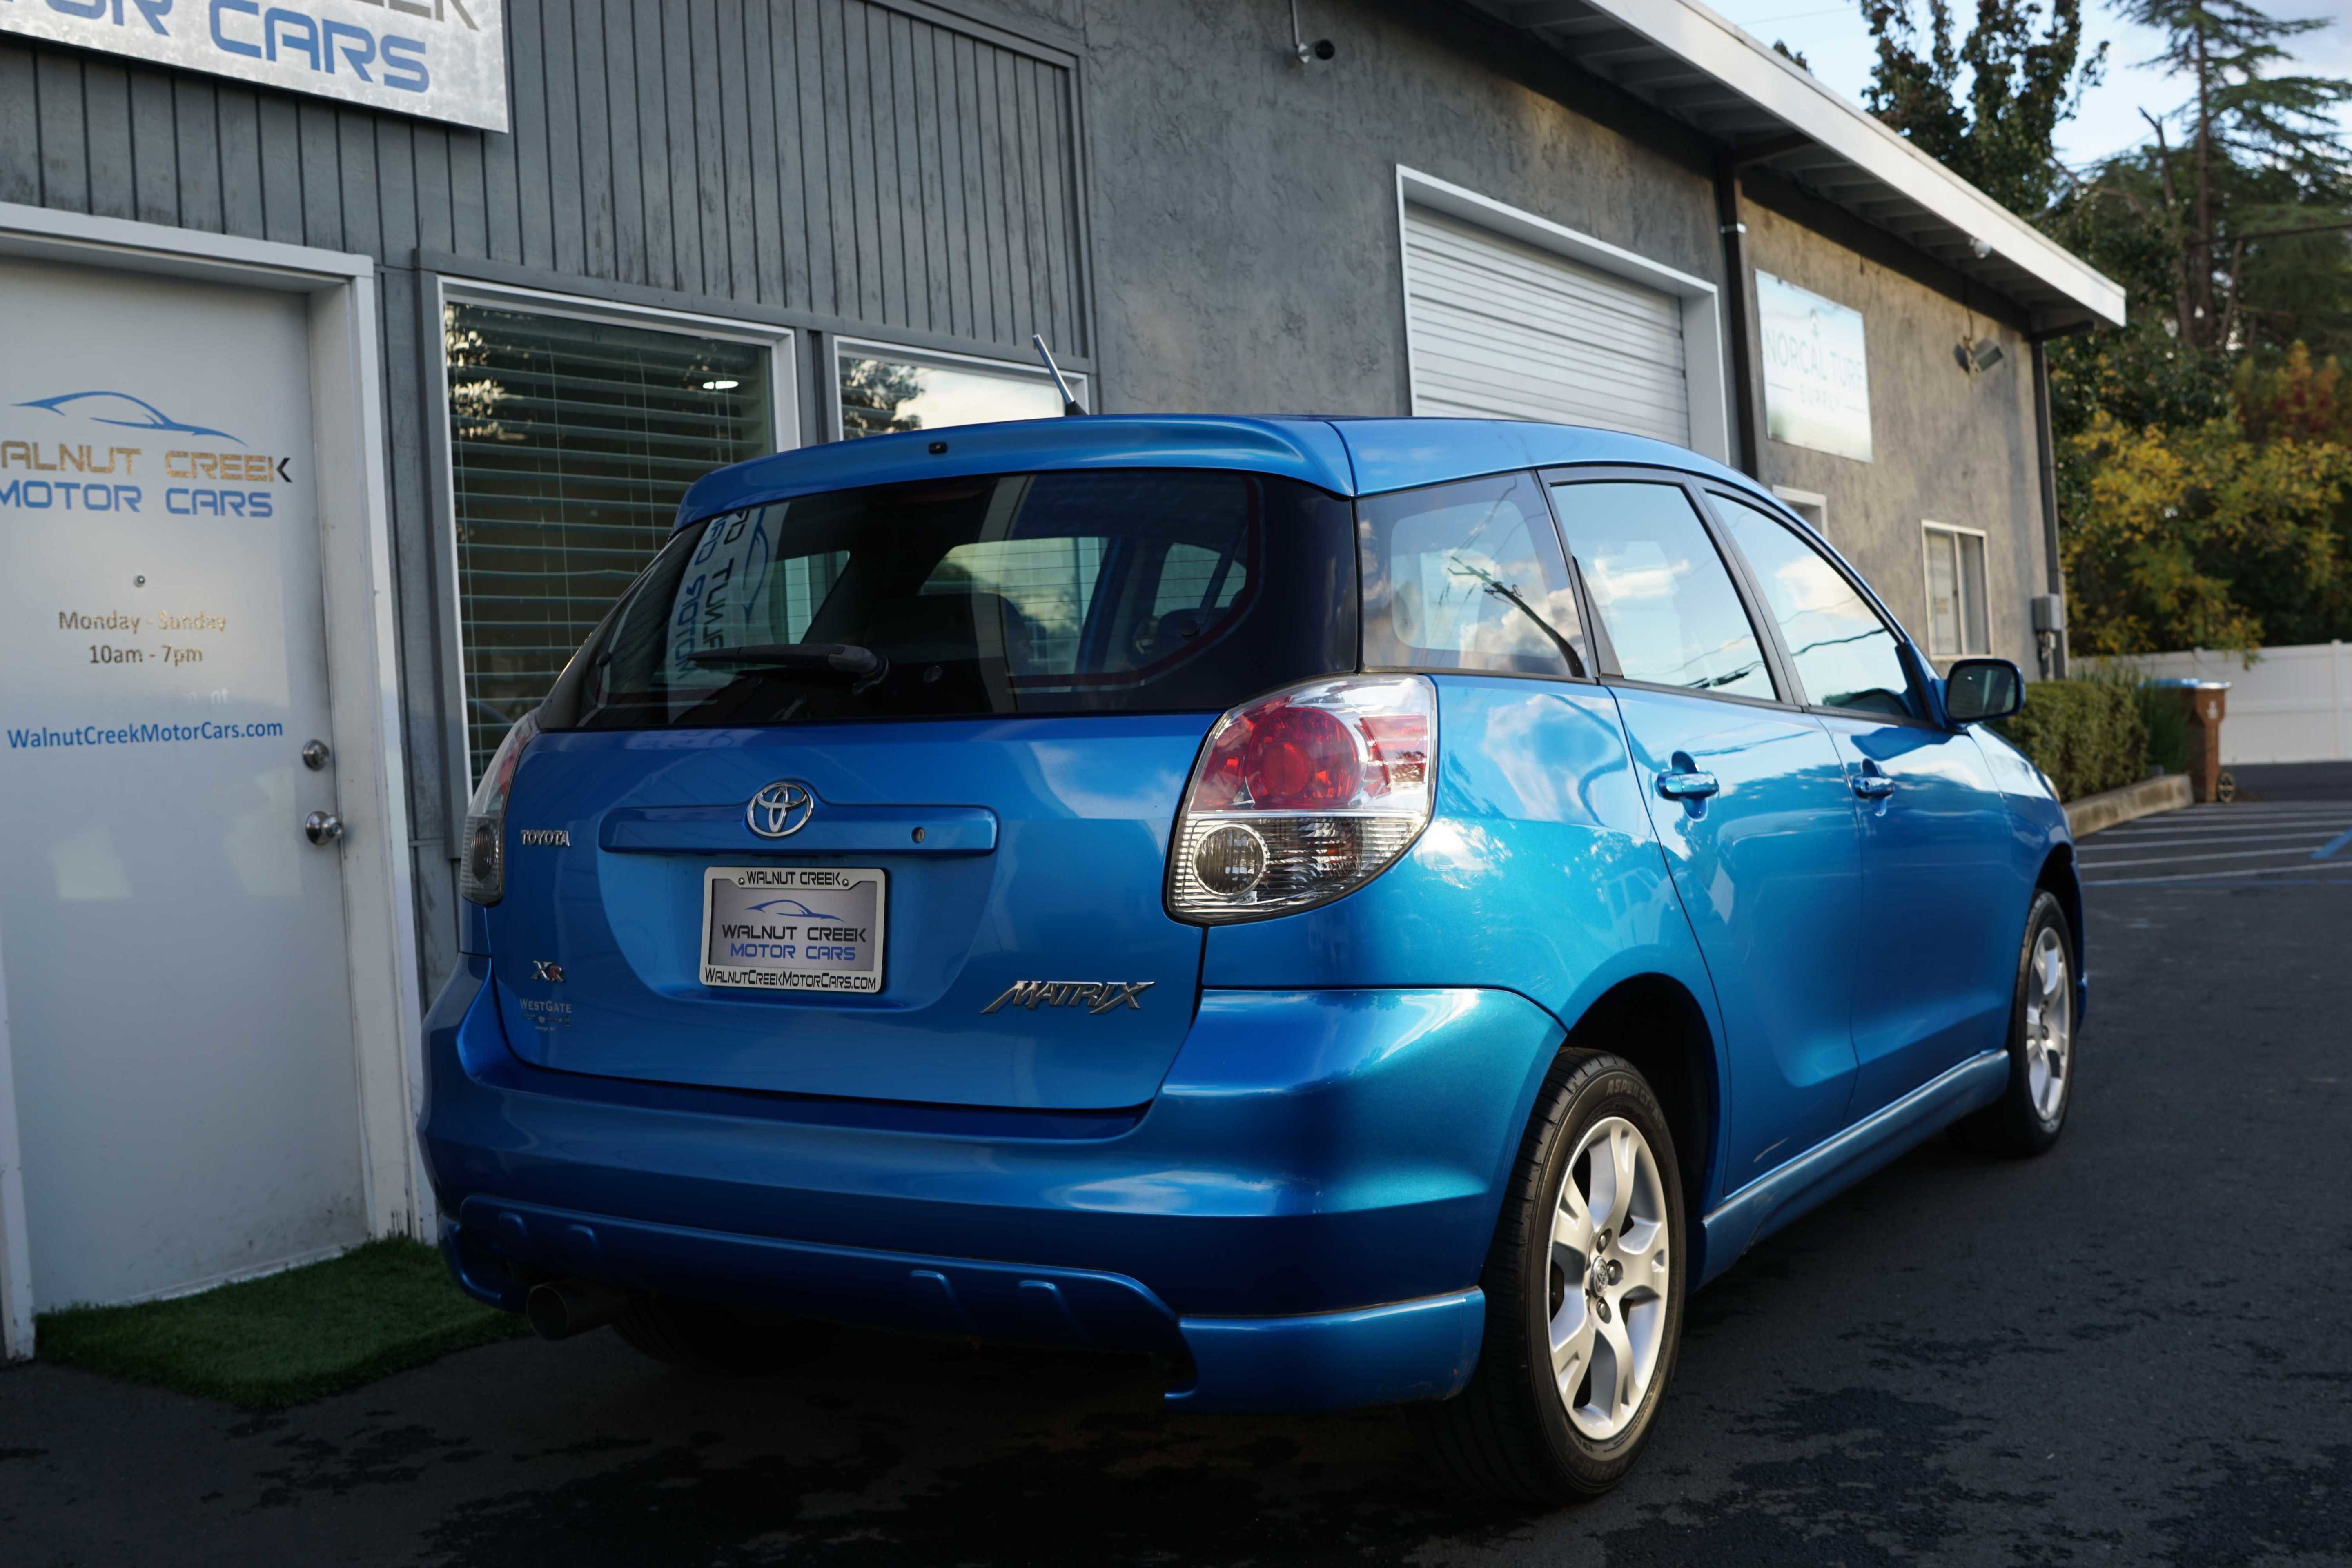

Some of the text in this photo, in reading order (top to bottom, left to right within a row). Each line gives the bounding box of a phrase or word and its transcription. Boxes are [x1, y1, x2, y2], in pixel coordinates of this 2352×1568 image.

[209, 0, 430, 93] CARS
[1, 440, 293, 483] ALNUT CREEK
[0, 479, 273, 517] MOTOR CARS
[58, 610, 140, 634] Monday
[158, 610, 227, 633] Sunday
[90, 645, 143, 664] 10am
[163, 645, 203, 667] 7pm
[7, 721, 283, 748] WalnutCreekMotorCars.com
[521, 829, 571, 847] TOYOTA
[746, 871, 840, 886] WALNUT CREEK
[722, 924, 867, 942] WALNUT CREEK
[730, 943, 856, 961] MOTOR CARS
[530, 960, 564, 982] XR
[980, 980, 1155, 1014] MATRIX
